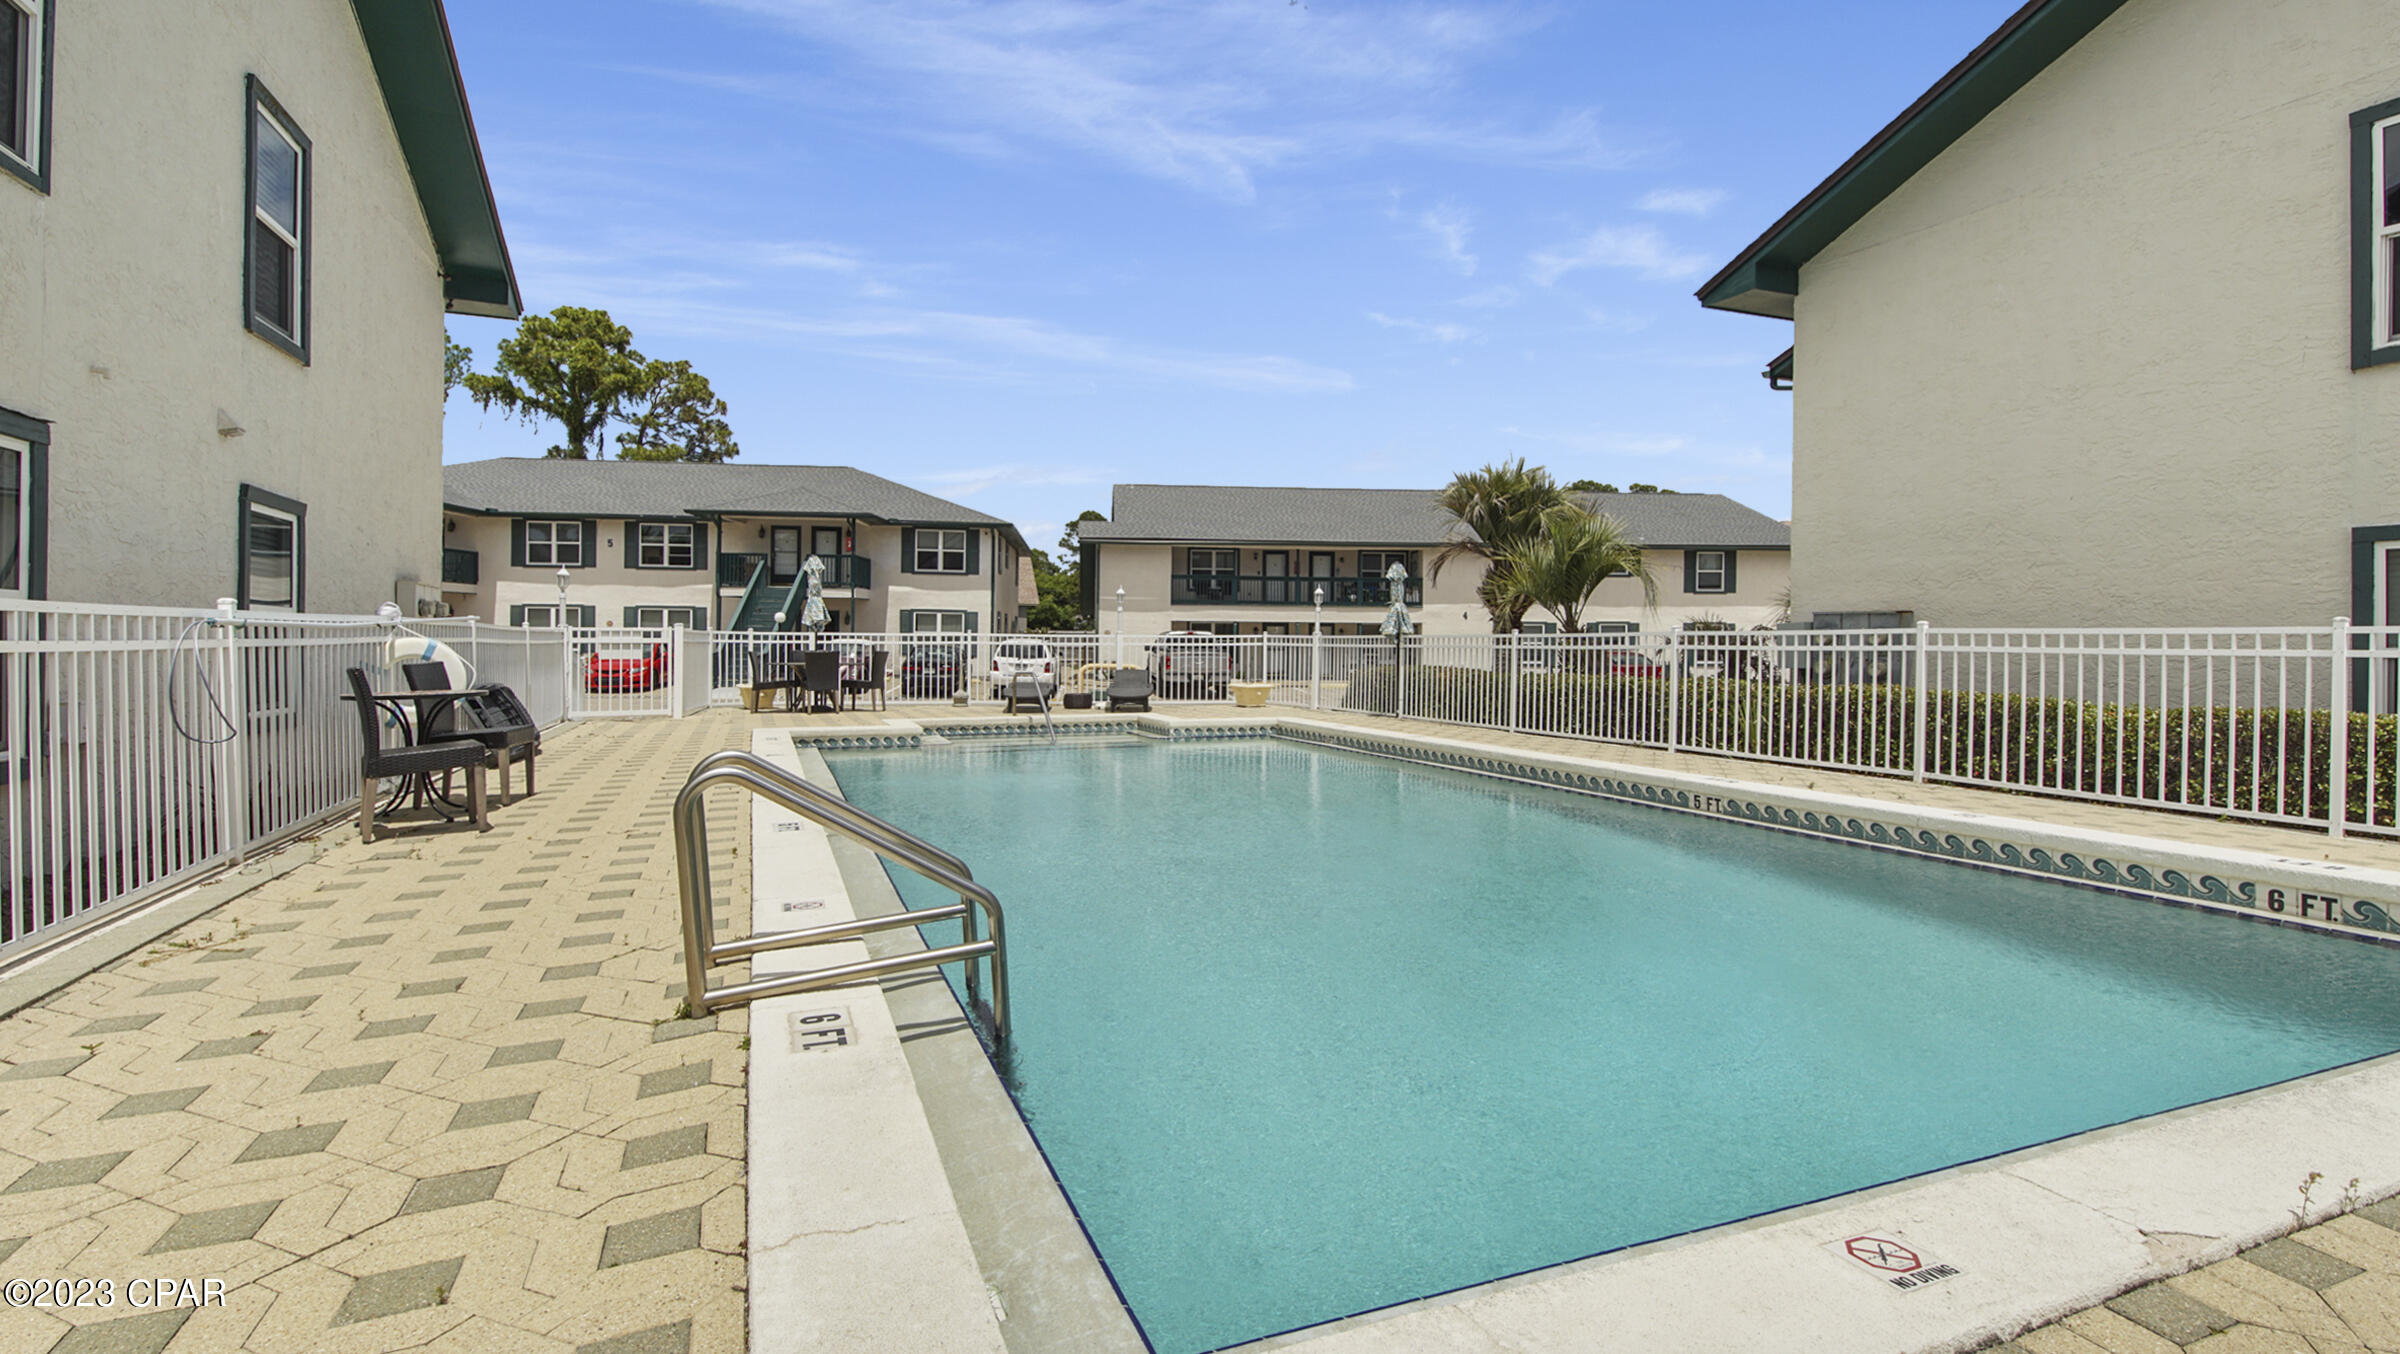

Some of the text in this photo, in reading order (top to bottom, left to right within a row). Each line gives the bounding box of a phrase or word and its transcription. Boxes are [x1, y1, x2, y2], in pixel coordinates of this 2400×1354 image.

[1693, 794, 1702, 809] 5
[2267, 888, 2338, 922] 6 FT.
[800, 1013, 842, 1025] 6
[1889, 1264, 1961, 1290] NO DIVING
